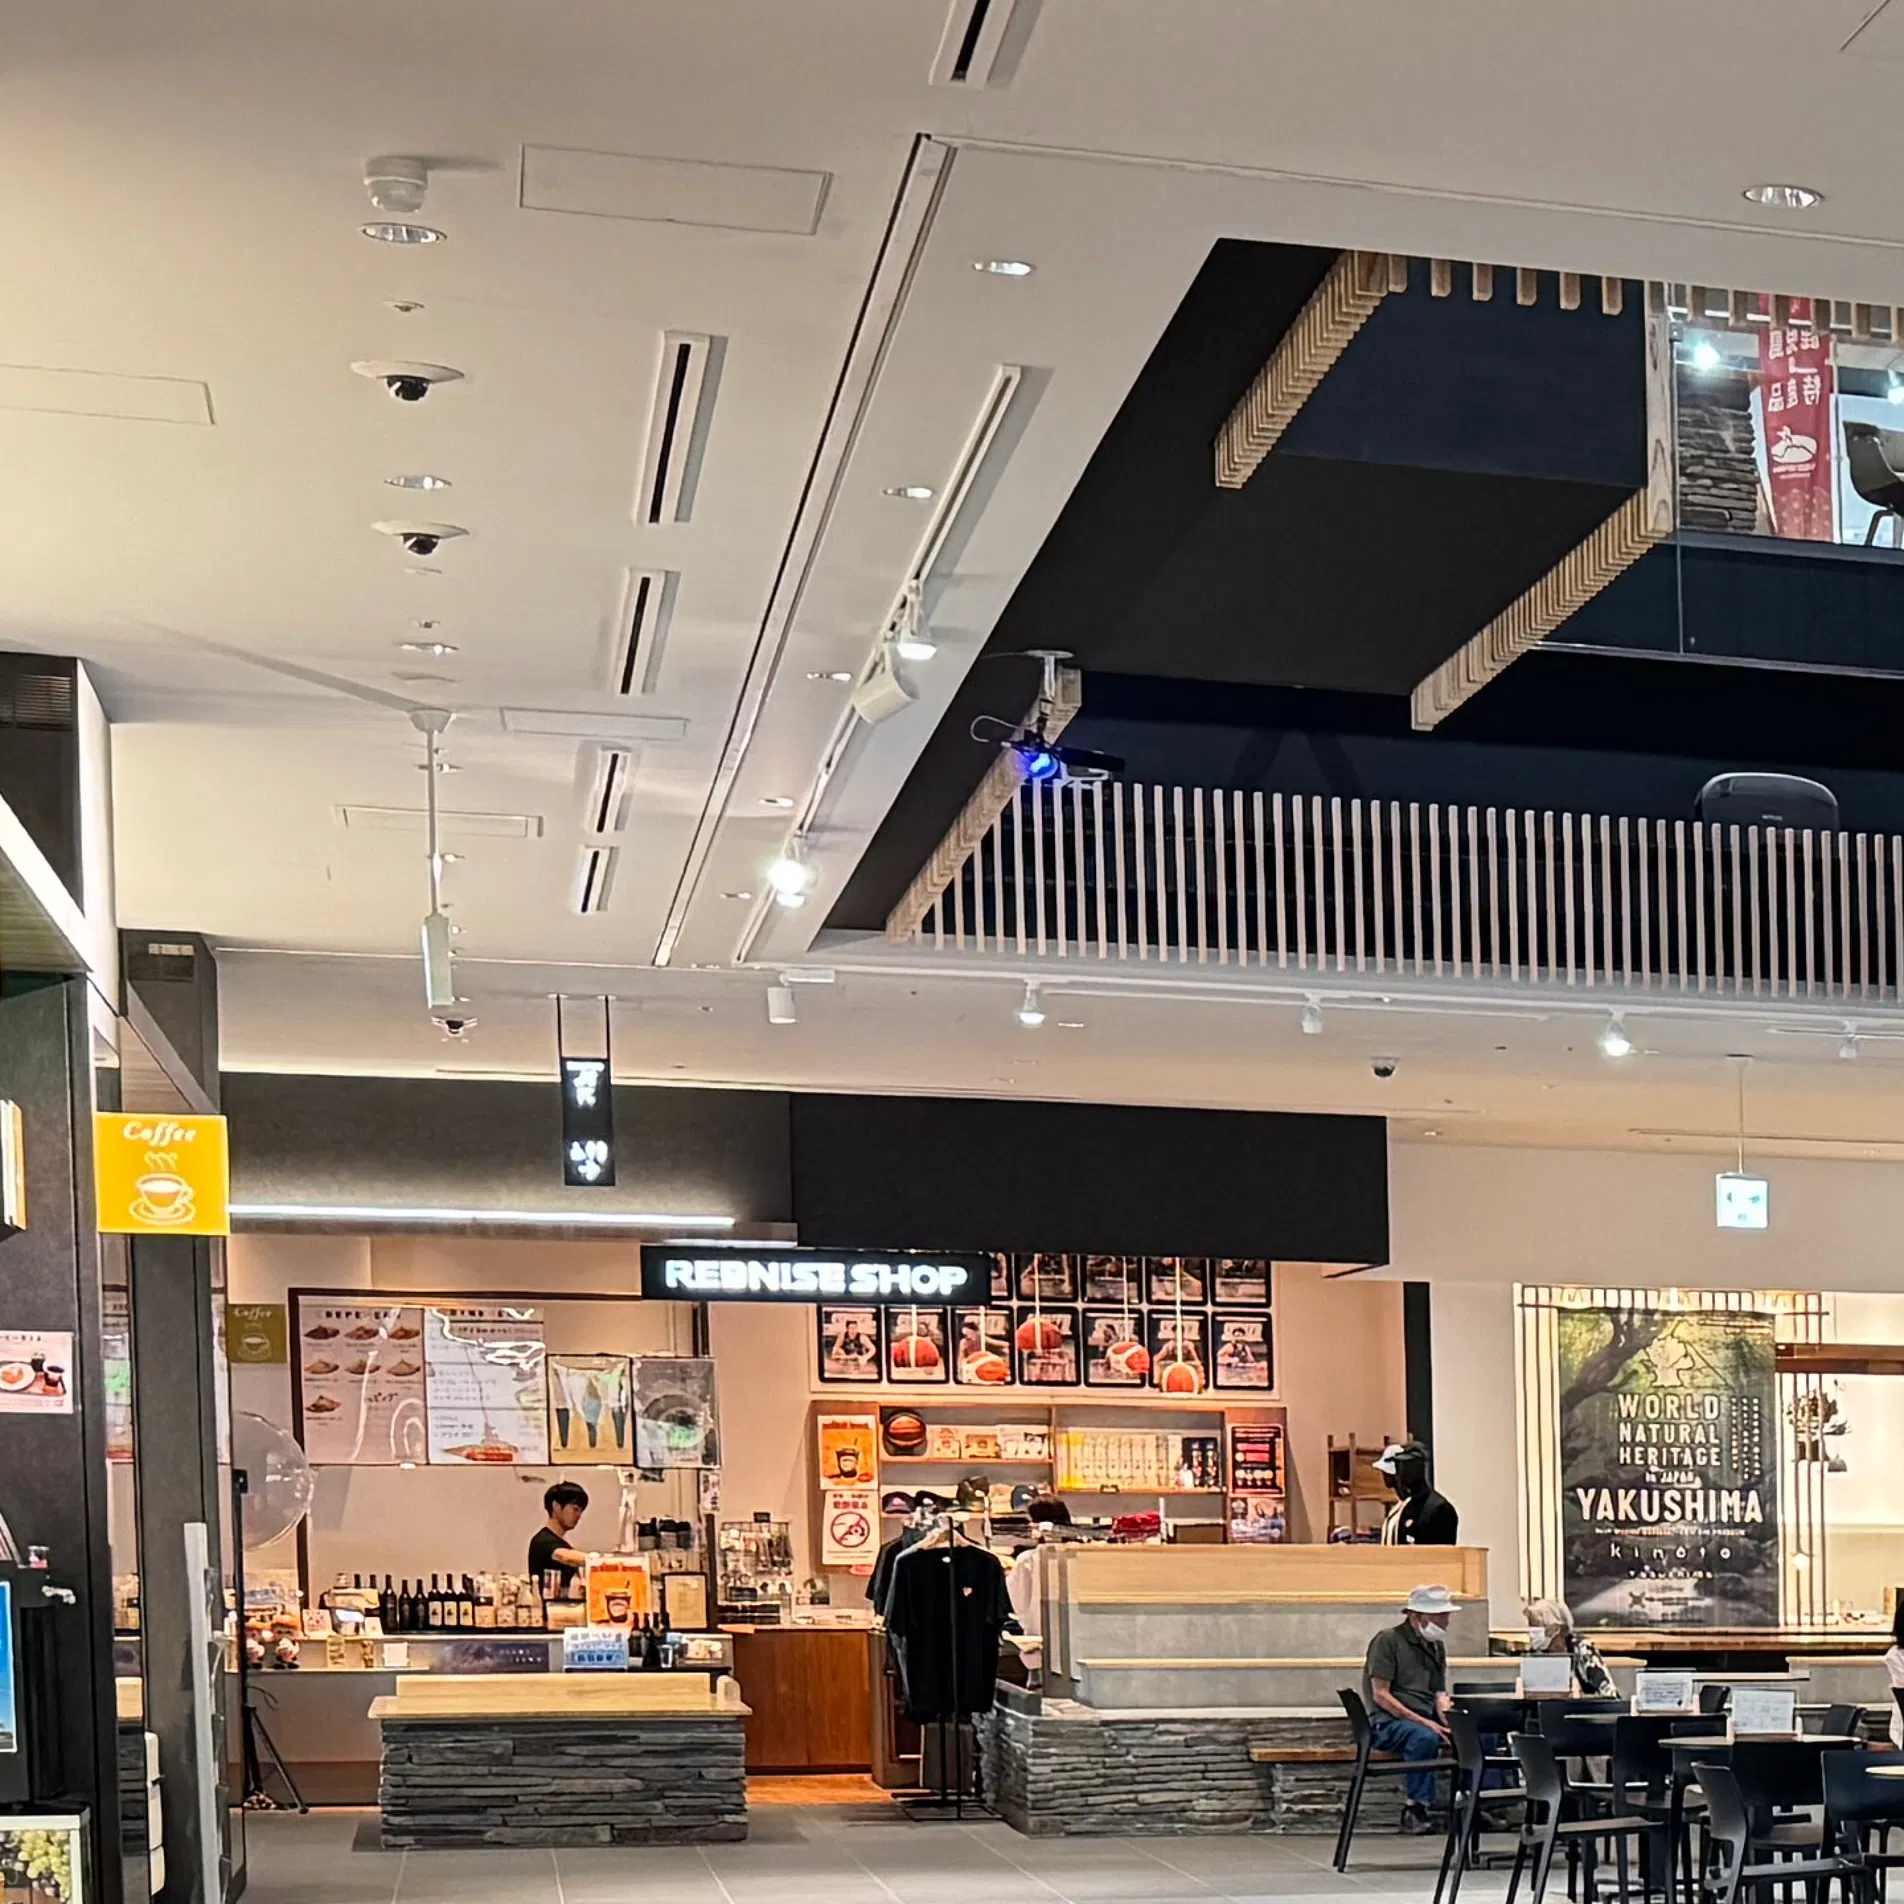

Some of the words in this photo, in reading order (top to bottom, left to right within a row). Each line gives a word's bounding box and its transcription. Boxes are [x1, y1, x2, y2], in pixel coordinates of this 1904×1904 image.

[123, 1121, 197, 1147] Coffee
[848, 1262, 969, 1296] SHOP
[234, 1306, 272, 1320] Coffee
[1618, 1393, 1720, 1419] WORLD
[1619, 1423, 1720, 1444] NATURAL
[1619, 1447, 1721, 1467] HERITAGE
[1660, 1470, 1697, 1484] JAPAN
[1576, 1487, 1764, 1523] YAKUSHIMA
